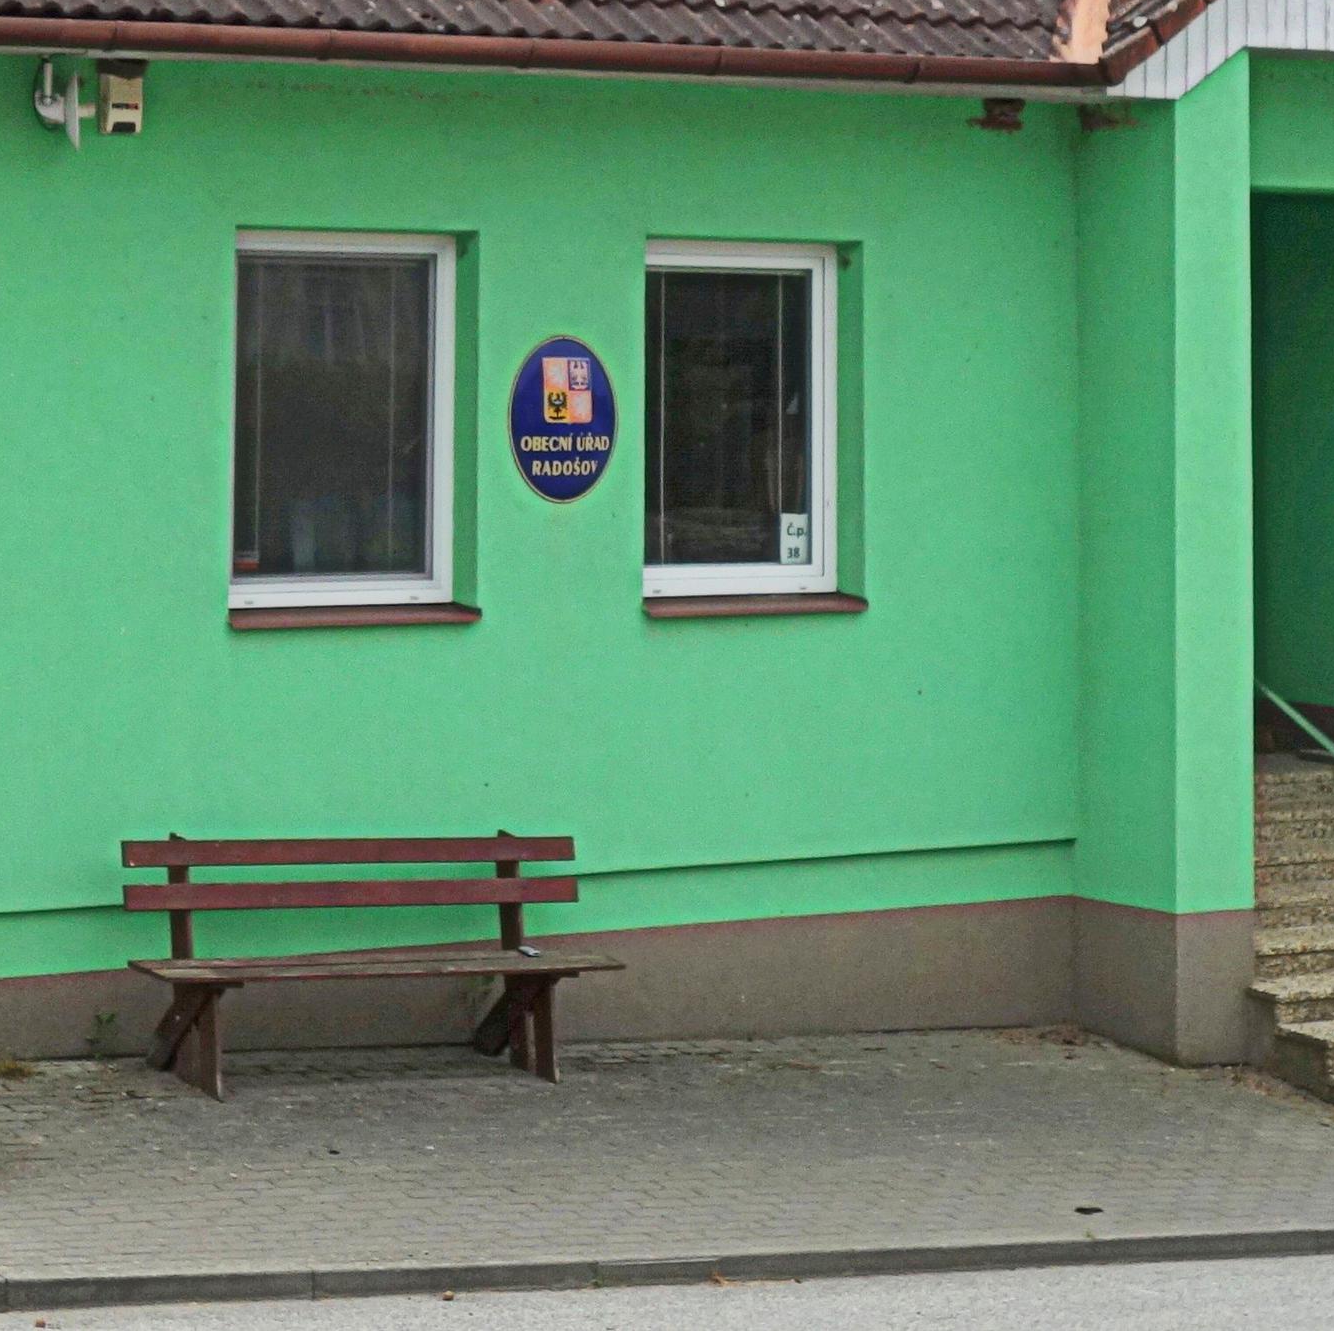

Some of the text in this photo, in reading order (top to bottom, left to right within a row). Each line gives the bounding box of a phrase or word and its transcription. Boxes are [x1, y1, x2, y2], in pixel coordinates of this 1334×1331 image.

[520, 431, 610, 452] OBECNÍ ÚŘAD
[532, 457, 598, 477] RADOŠOV
[786, 547, 800, 559] 38
